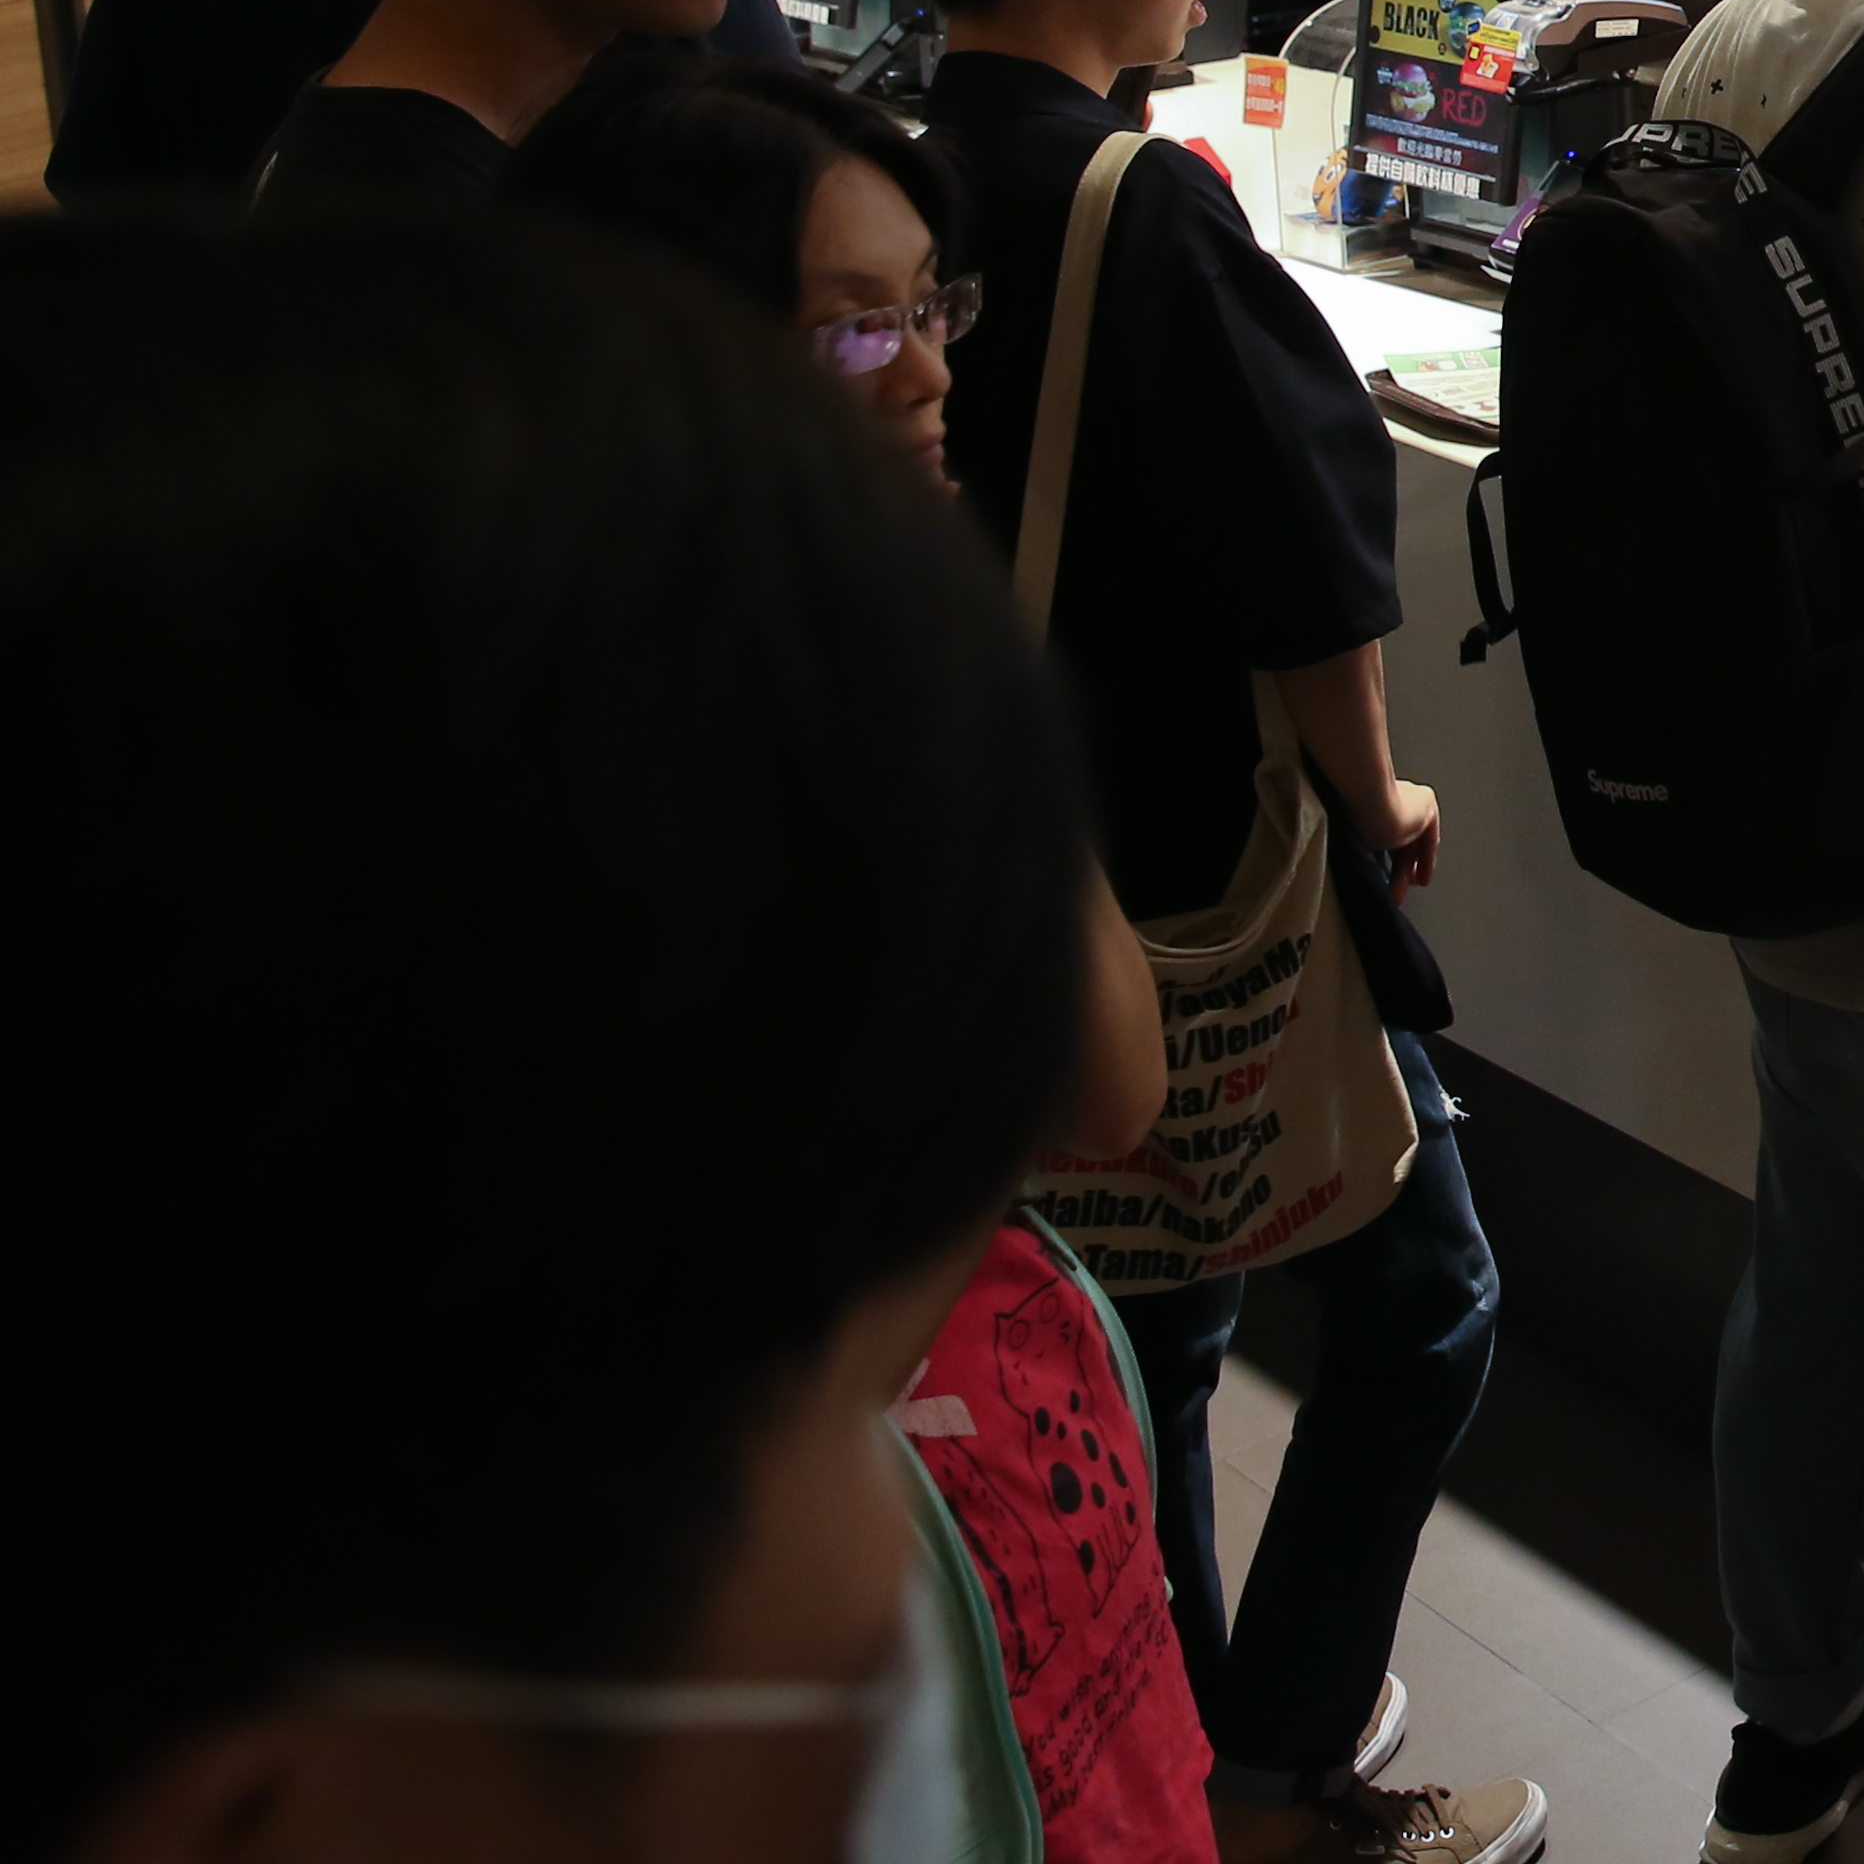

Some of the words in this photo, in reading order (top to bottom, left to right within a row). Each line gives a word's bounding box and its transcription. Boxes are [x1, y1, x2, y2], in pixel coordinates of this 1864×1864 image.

[1383, 2, 1440, 40] BLACK
[1442, 88, 1487, 127] RED
[1587, 770, 1669, 804] Supreme
